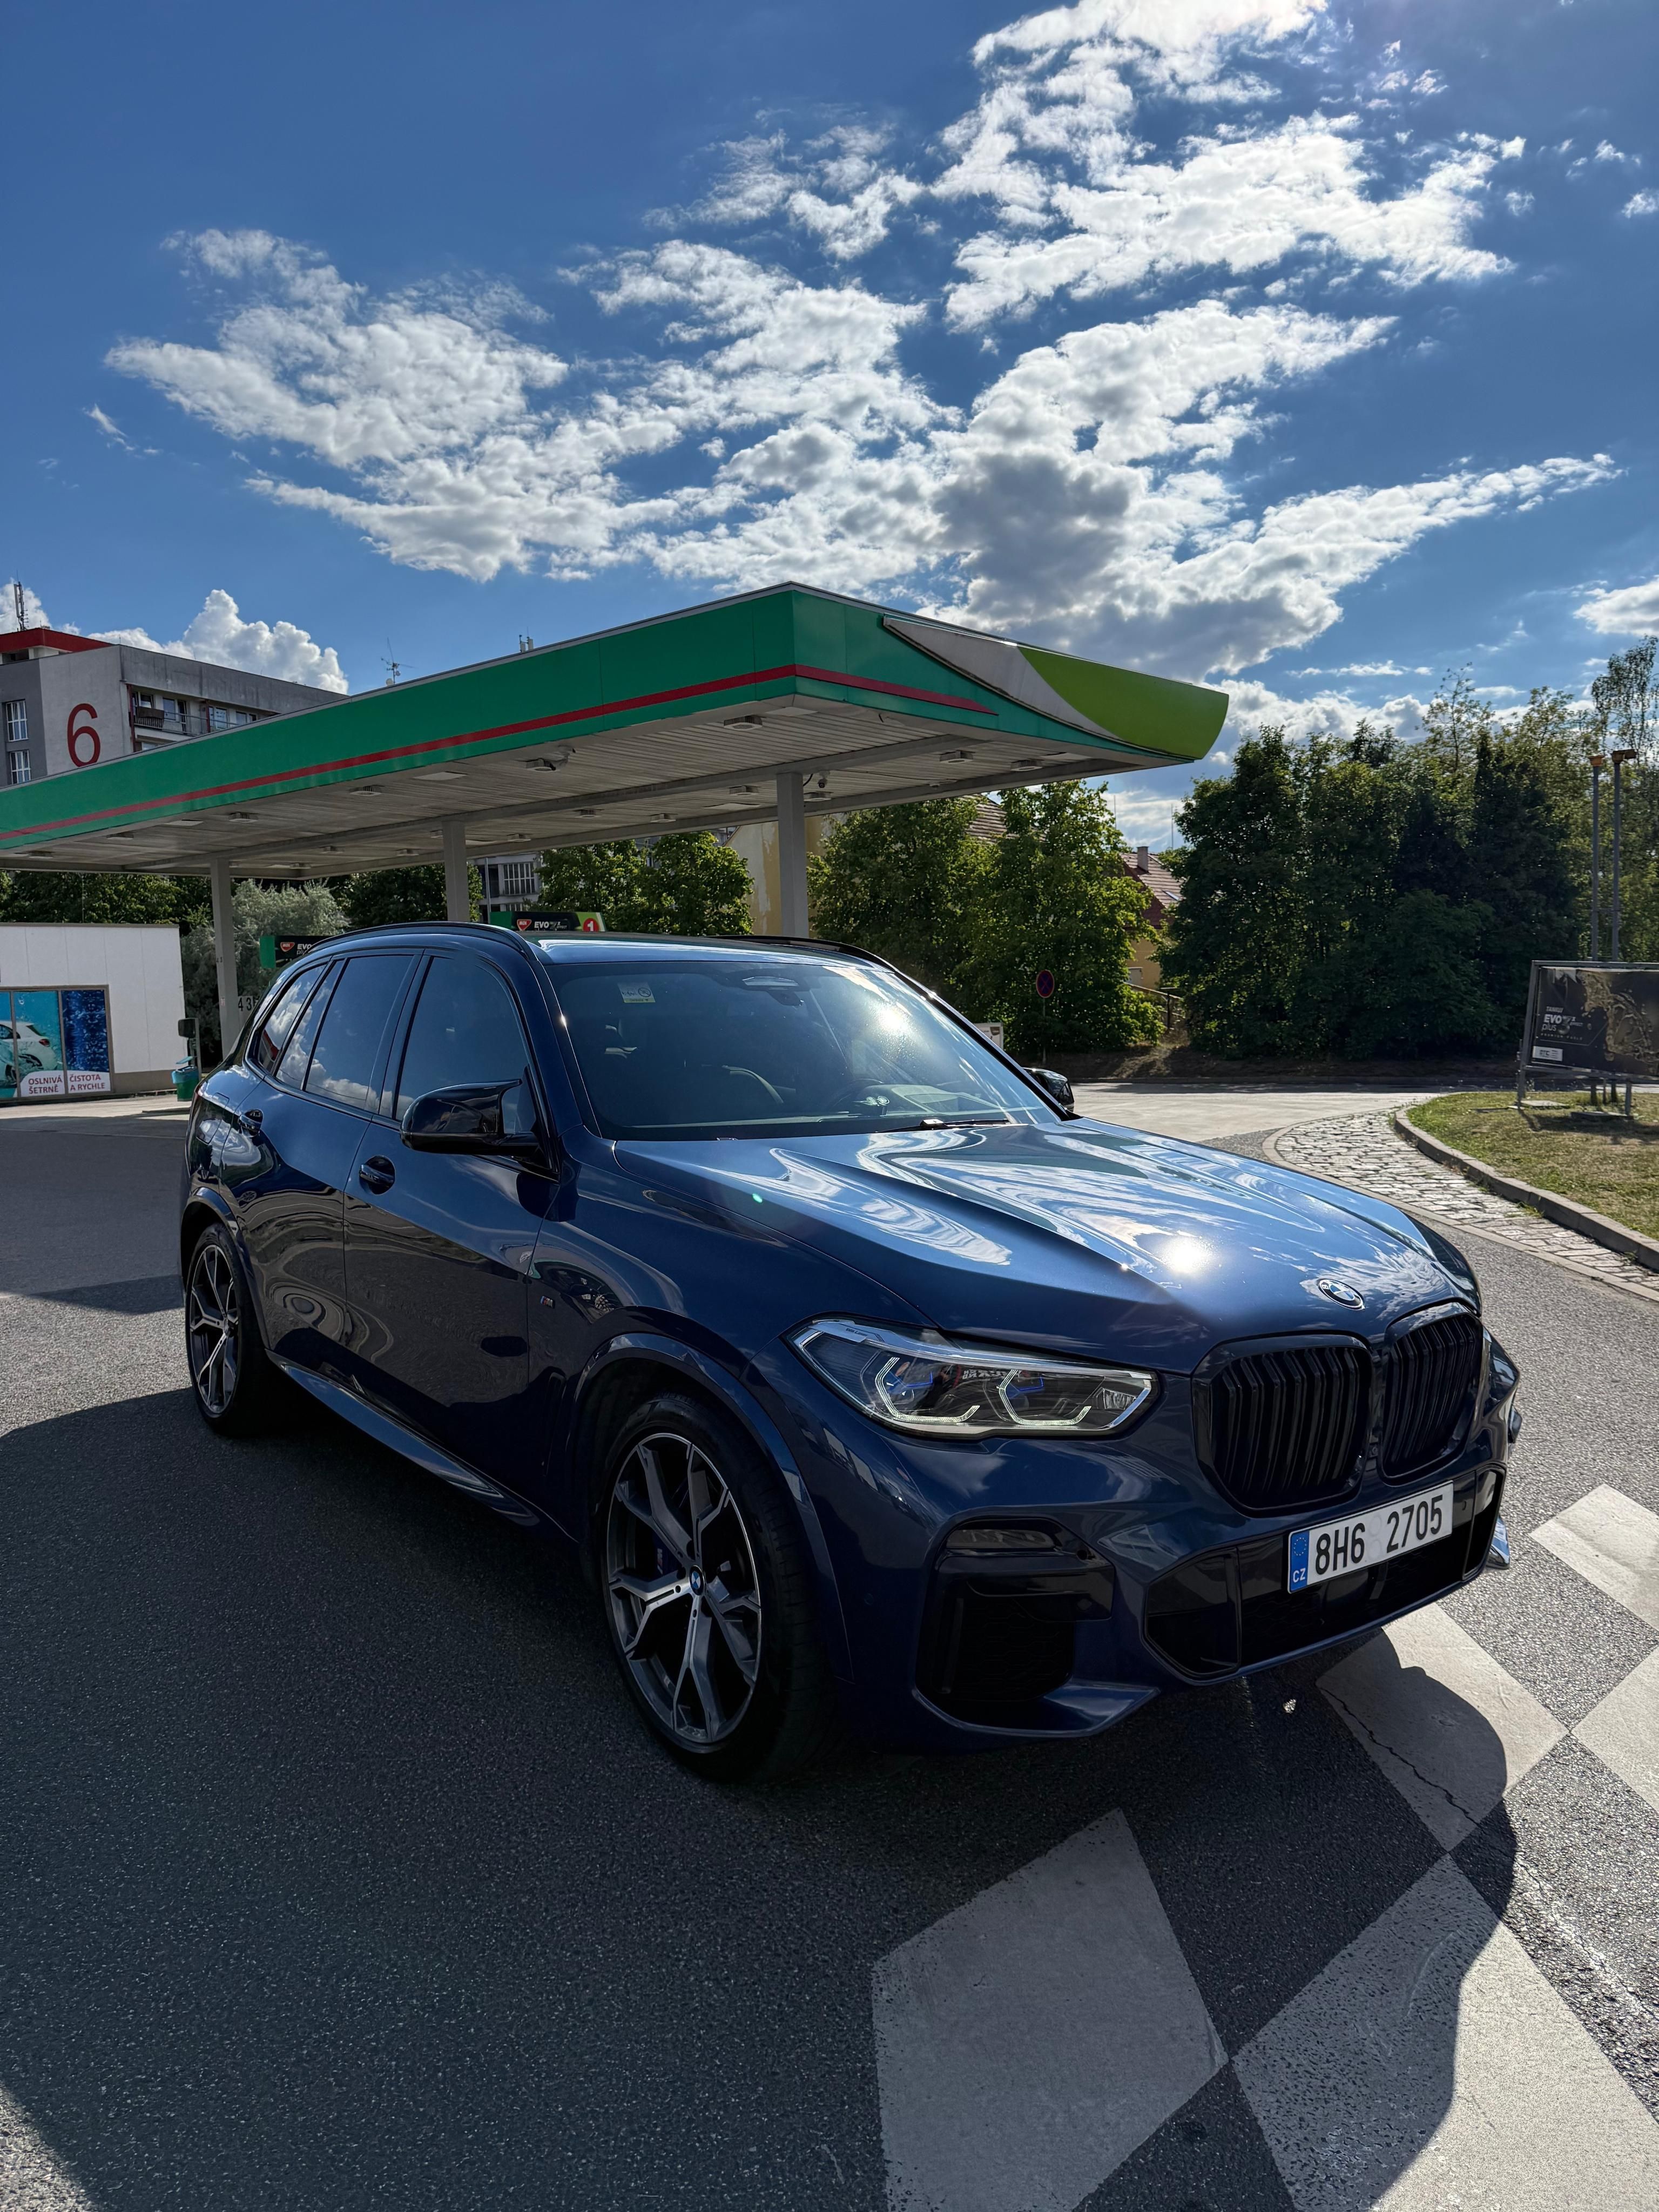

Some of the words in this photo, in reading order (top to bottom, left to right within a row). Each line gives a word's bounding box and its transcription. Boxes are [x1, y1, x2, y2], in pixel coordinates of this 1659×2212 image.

[67, 703, 100, 767] 6
[534, 921, 548, 929] EVO
[587, 921, 594, 932] 1
[1544, 1014, 1562, 1024] EVO
[28, 1075, 63, 1085] OSLNIVÁ
[69, 1074, 102, 1082] ČISTOTA
[29, 1084, 59, 1094] ŠETRNĚ
[78, 1082, 105, 1090] RYCHLE
[1315, 1522, 1365, 1575] 8H6
[1386, 1494, 1444, 1554] 2705
[1293, 1568, 1306, 1583] CZ
